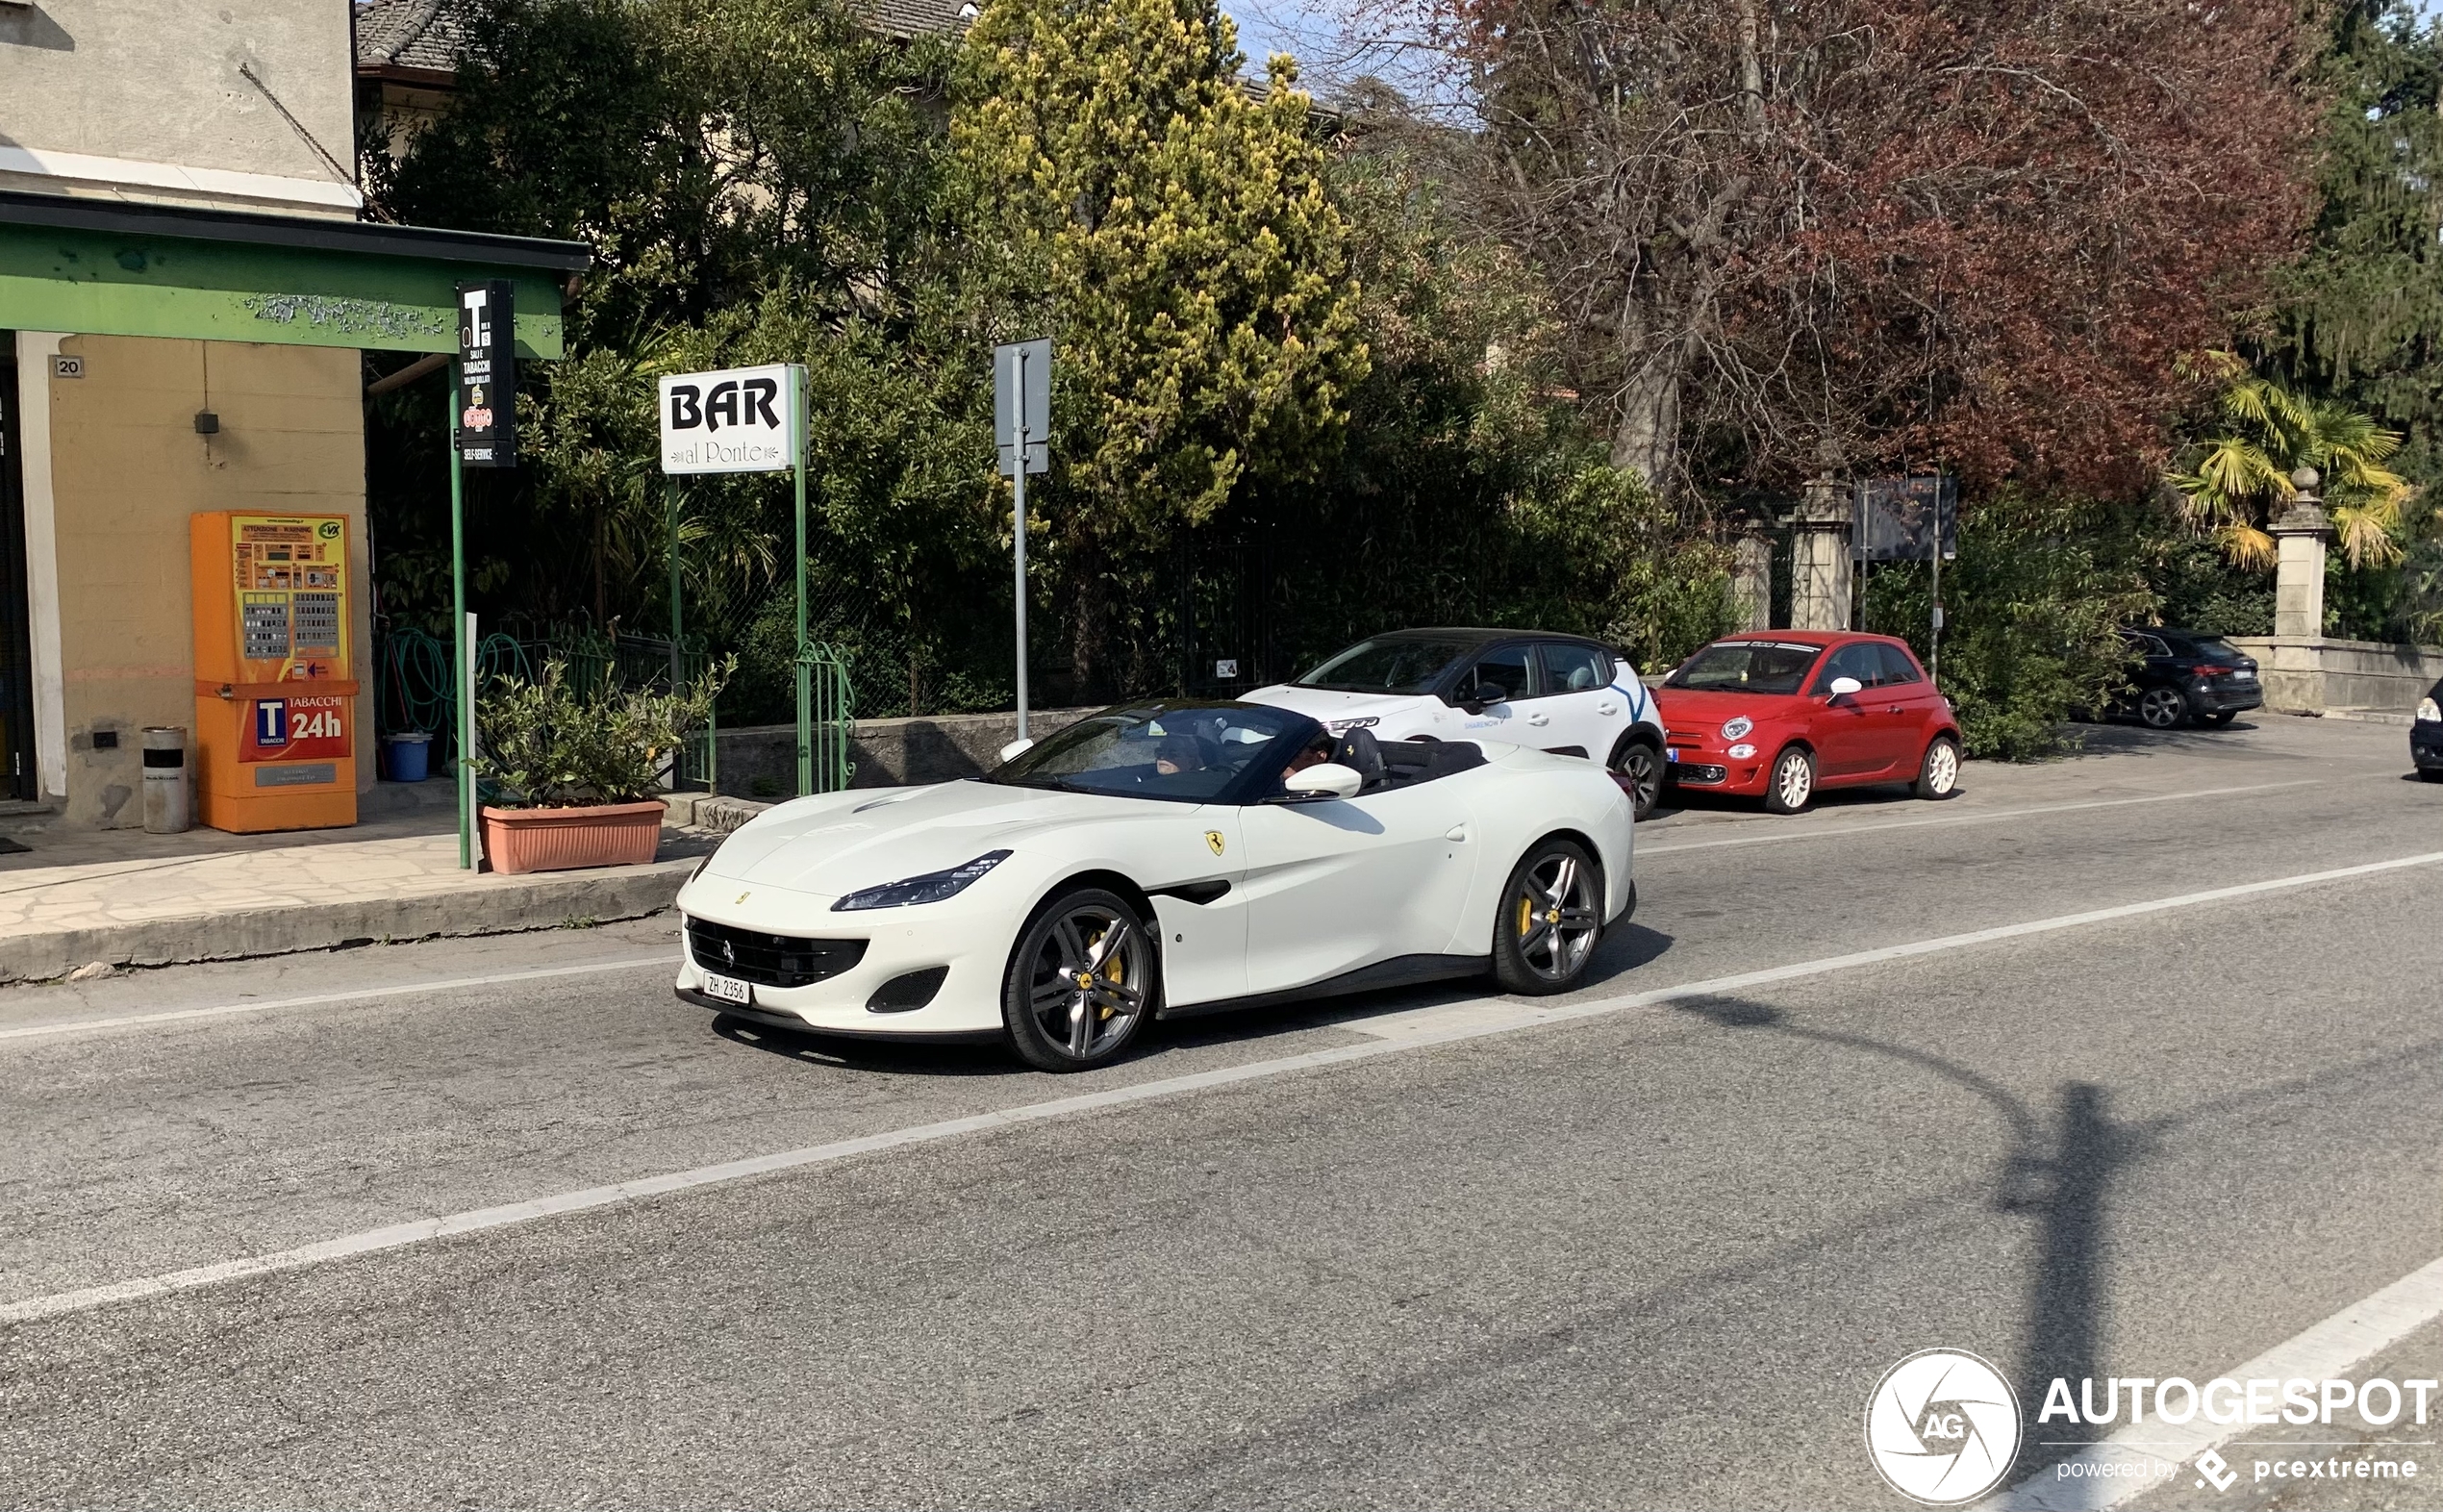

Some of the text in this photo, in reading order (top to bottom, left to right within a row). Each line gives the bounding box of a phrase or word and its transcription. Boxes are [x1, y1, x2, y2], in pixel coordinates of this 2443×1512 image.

[464, 290, 487, 348] T
[59, 361, 78, 373] 20
[464, 360, 491, 374] TABACCHI
[670, 378, 781, 433] BAR
[465, 409, 492, 427] LOTTO
[464, 448, 492, 461] SELF-SERVICE
[685, 441, 762, 465] al Ponte
[289, 696, 341, 708] TABACCHI
[259, 702, 283, 737] T
[292, 711, 341, 739] 24h
[709, 976, 744, 999] ZH 2356
